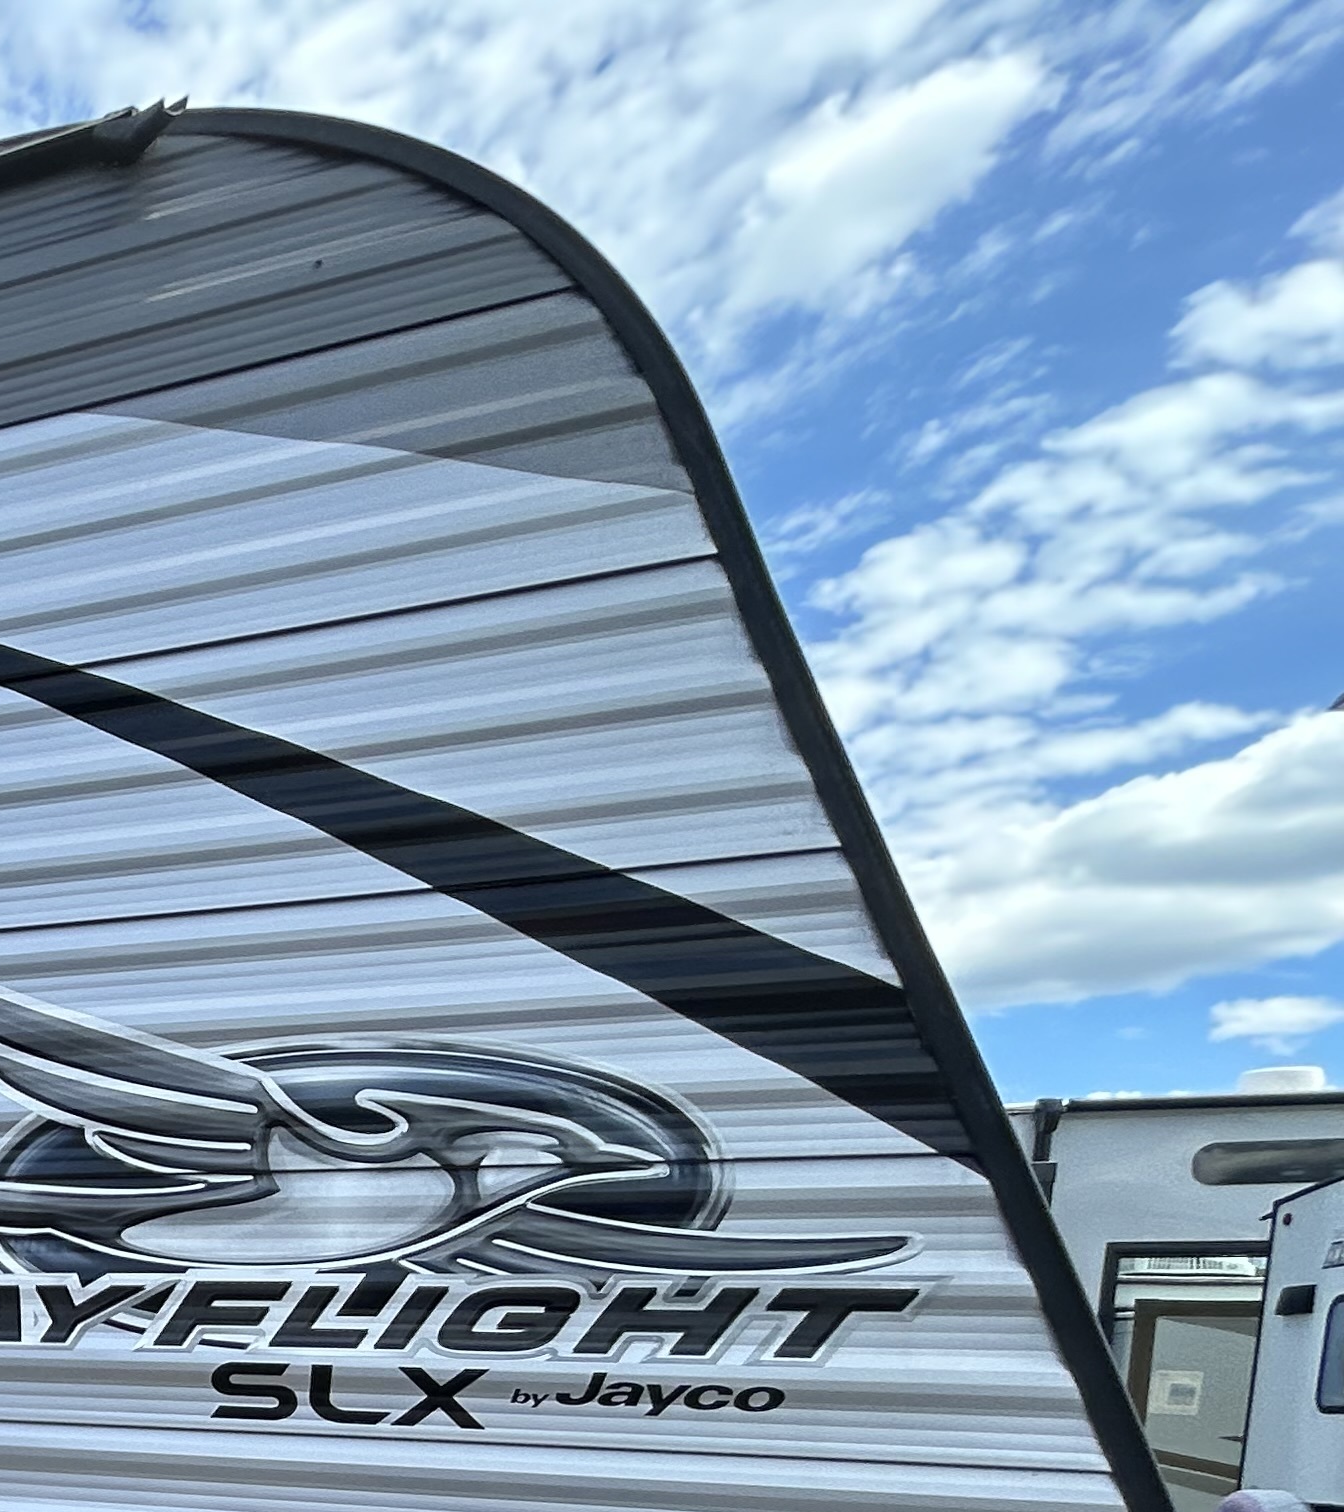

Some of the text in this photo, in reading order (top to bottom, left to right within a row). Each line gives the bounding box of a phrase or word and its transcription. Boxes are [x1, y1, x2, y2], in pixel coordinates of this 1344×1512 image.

[152, 1277, 921, 1359] FLIGHT
[210, 1361, 786, 1432] SLX by Jayco
